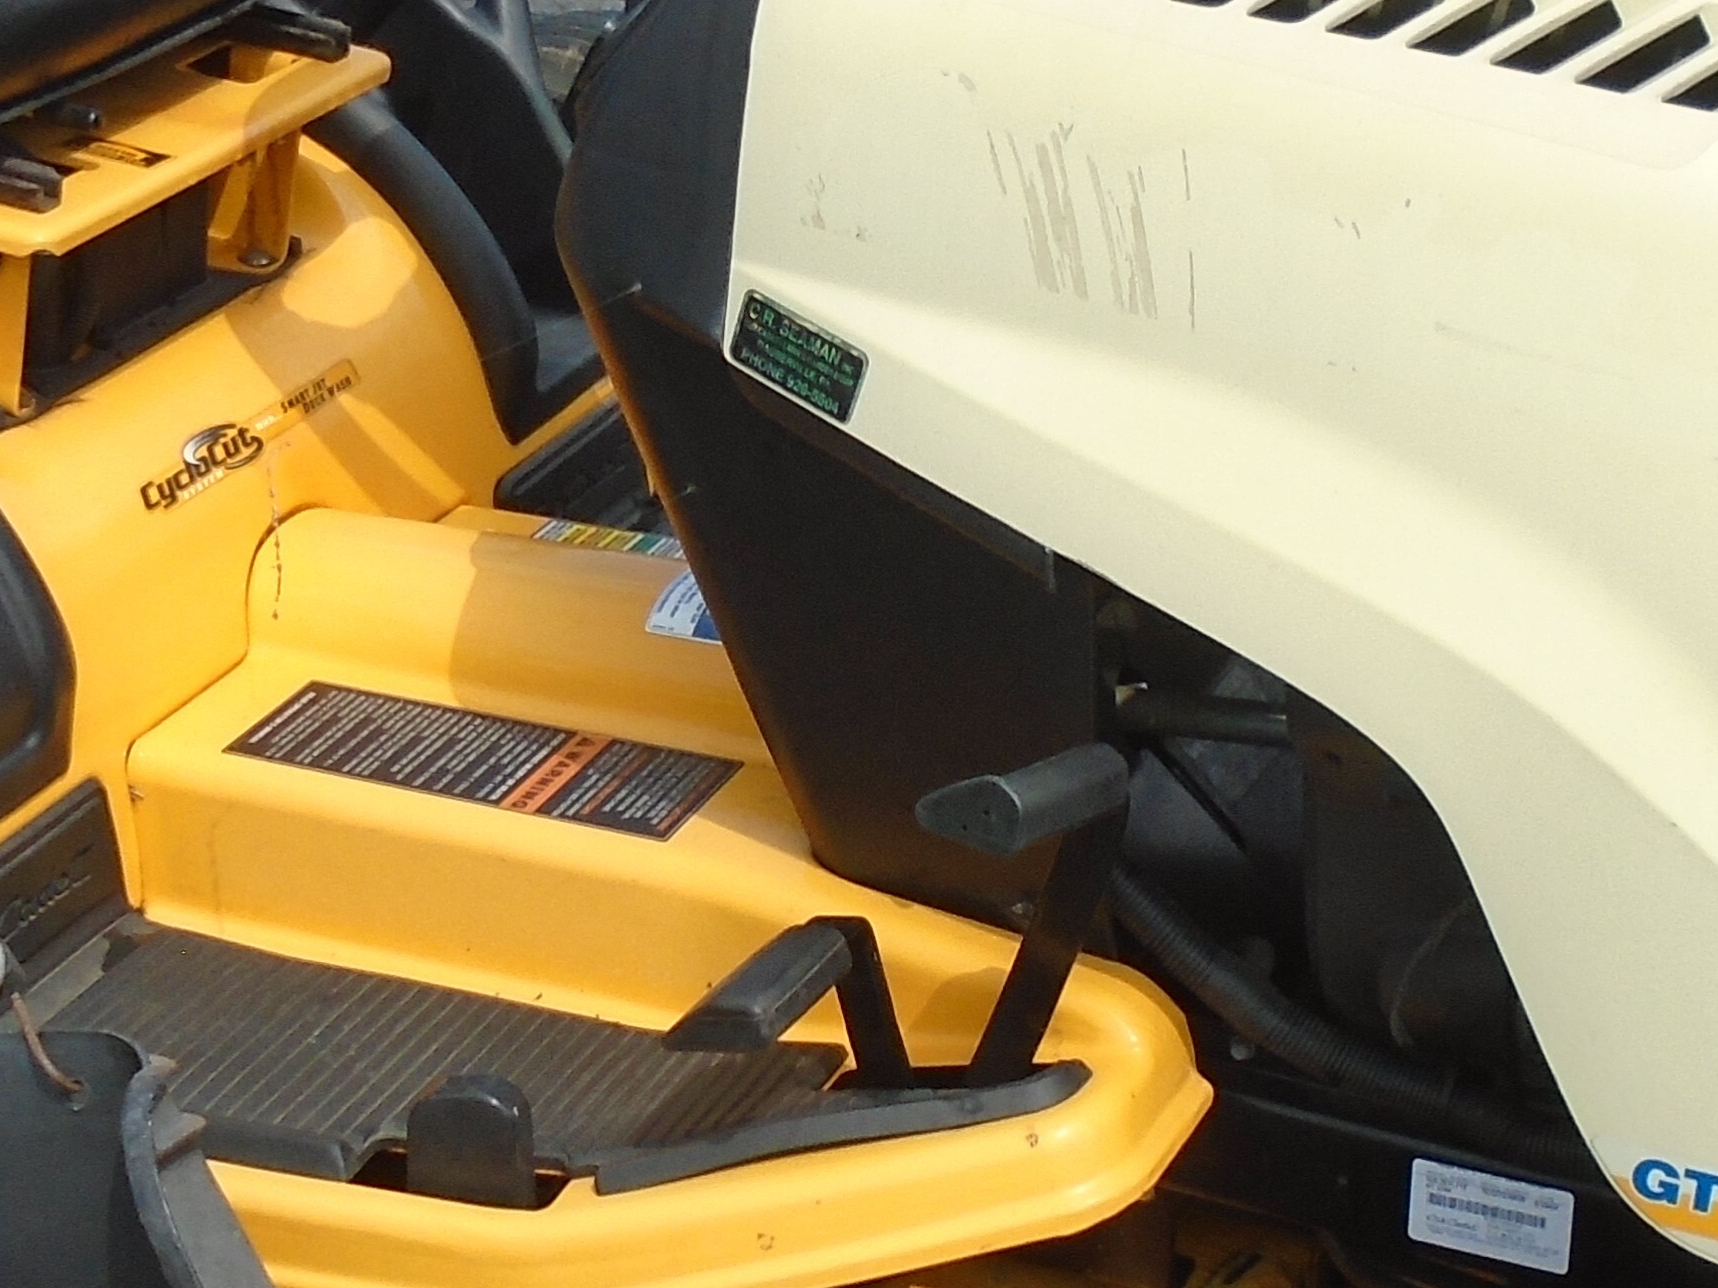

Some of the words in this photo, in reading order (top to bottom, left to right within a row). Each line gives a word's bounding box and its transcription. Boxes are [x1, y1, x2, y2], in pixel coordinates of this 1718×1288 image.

[740, 347, 784, 382] PHONE
[779, 318, 842, 366] SEAMAN
[139, 423, 265, 510] CycloCut
[511, 750, 582, 810] WARNING
